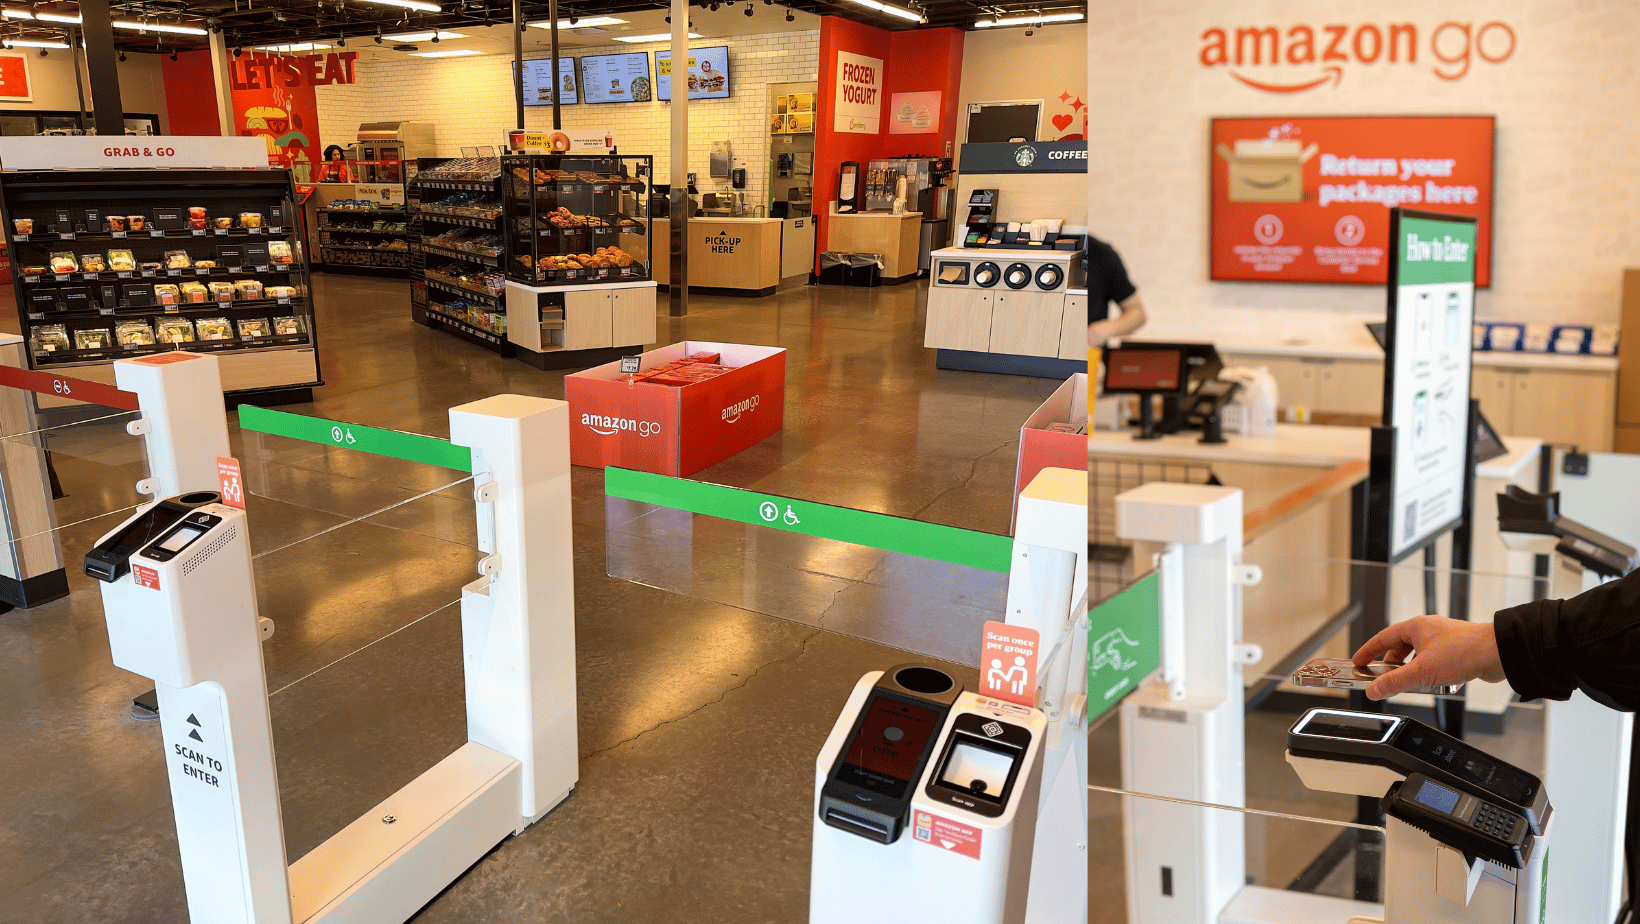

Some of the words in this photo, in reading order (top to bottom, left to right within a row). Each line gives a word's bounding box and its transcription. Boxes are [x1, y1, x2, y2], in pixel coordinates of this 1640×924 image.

[1199, 21, 1418, 68] amazon
[1430, 20, 1517, 82] go
[230, 54, 302, 91] LET'S
[305, 51, 360, 86] EAT
[843, 62, 875, 85] FROZEN
[842, 84, 877, 106] YOGURT
[103, 147, 140, 157] GRAB
[143, 147, 153, 157] &
[156, 147, 175, 157] GO
[1048, 150, 1088, 160] COFFEE
[1319, 153, 1398, 177] Return
[1399, 158, 1457, 181] your
[1318, 179, 1423, 208] packages
[1424, 179, 1479, 205] here
[705, 236, 741, 246] PICK-UP
[711, 246, 735, 254] HERE
[1406, 232, 1431, 262] How
[1432, 237, 1443, 262] to
[1443, 235, 1470, 262] Enter
[721, 399, 750, 420] amazon
[749, 394, 760, 411] go
[581, 412, 637, 432] amazon
[638, 420, 661, 437] go
[986, 631, 1010, 643] Scan
[1011, 637, 1035, 648] once
[986, 641, 1003, 650] per
[1004, 645, 1033, 657] group
[175, 743, 205, 766] SCAN
[206, 756, 223, 773] TO
[183, 763, 219, 788] ENTER
